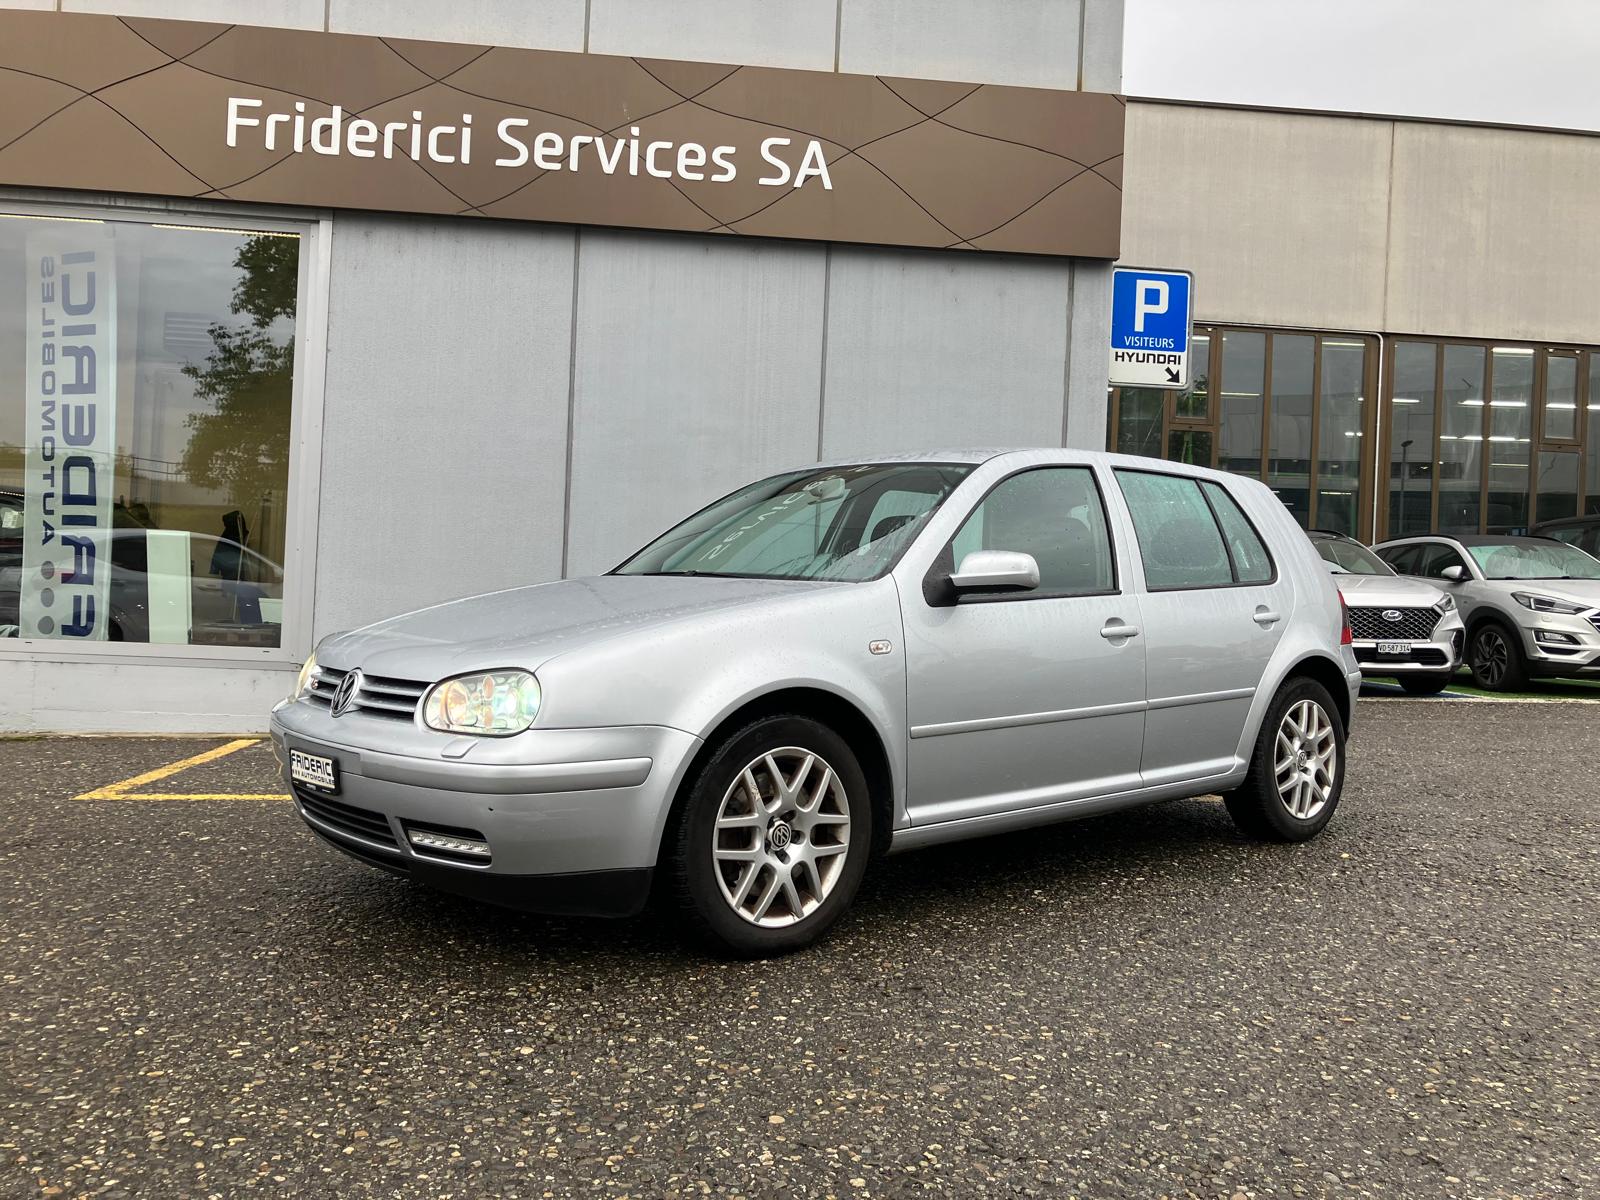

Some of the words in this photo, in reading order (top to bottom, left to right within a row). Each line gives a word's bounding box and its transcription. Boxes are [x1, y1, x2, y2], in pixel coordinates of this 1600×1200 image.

[225, 96, 474, 166] Friderici
[494, 116, 738, 184] Services
[757, 137, 834, 191] SA
[1134, 279, 1170, 332] P
[1124, 335, 1175, 349] VISITEURS
[1114, 351, 1182, 365] HYUNDAI
[291, 752, 334, 778] FRIDERIC
